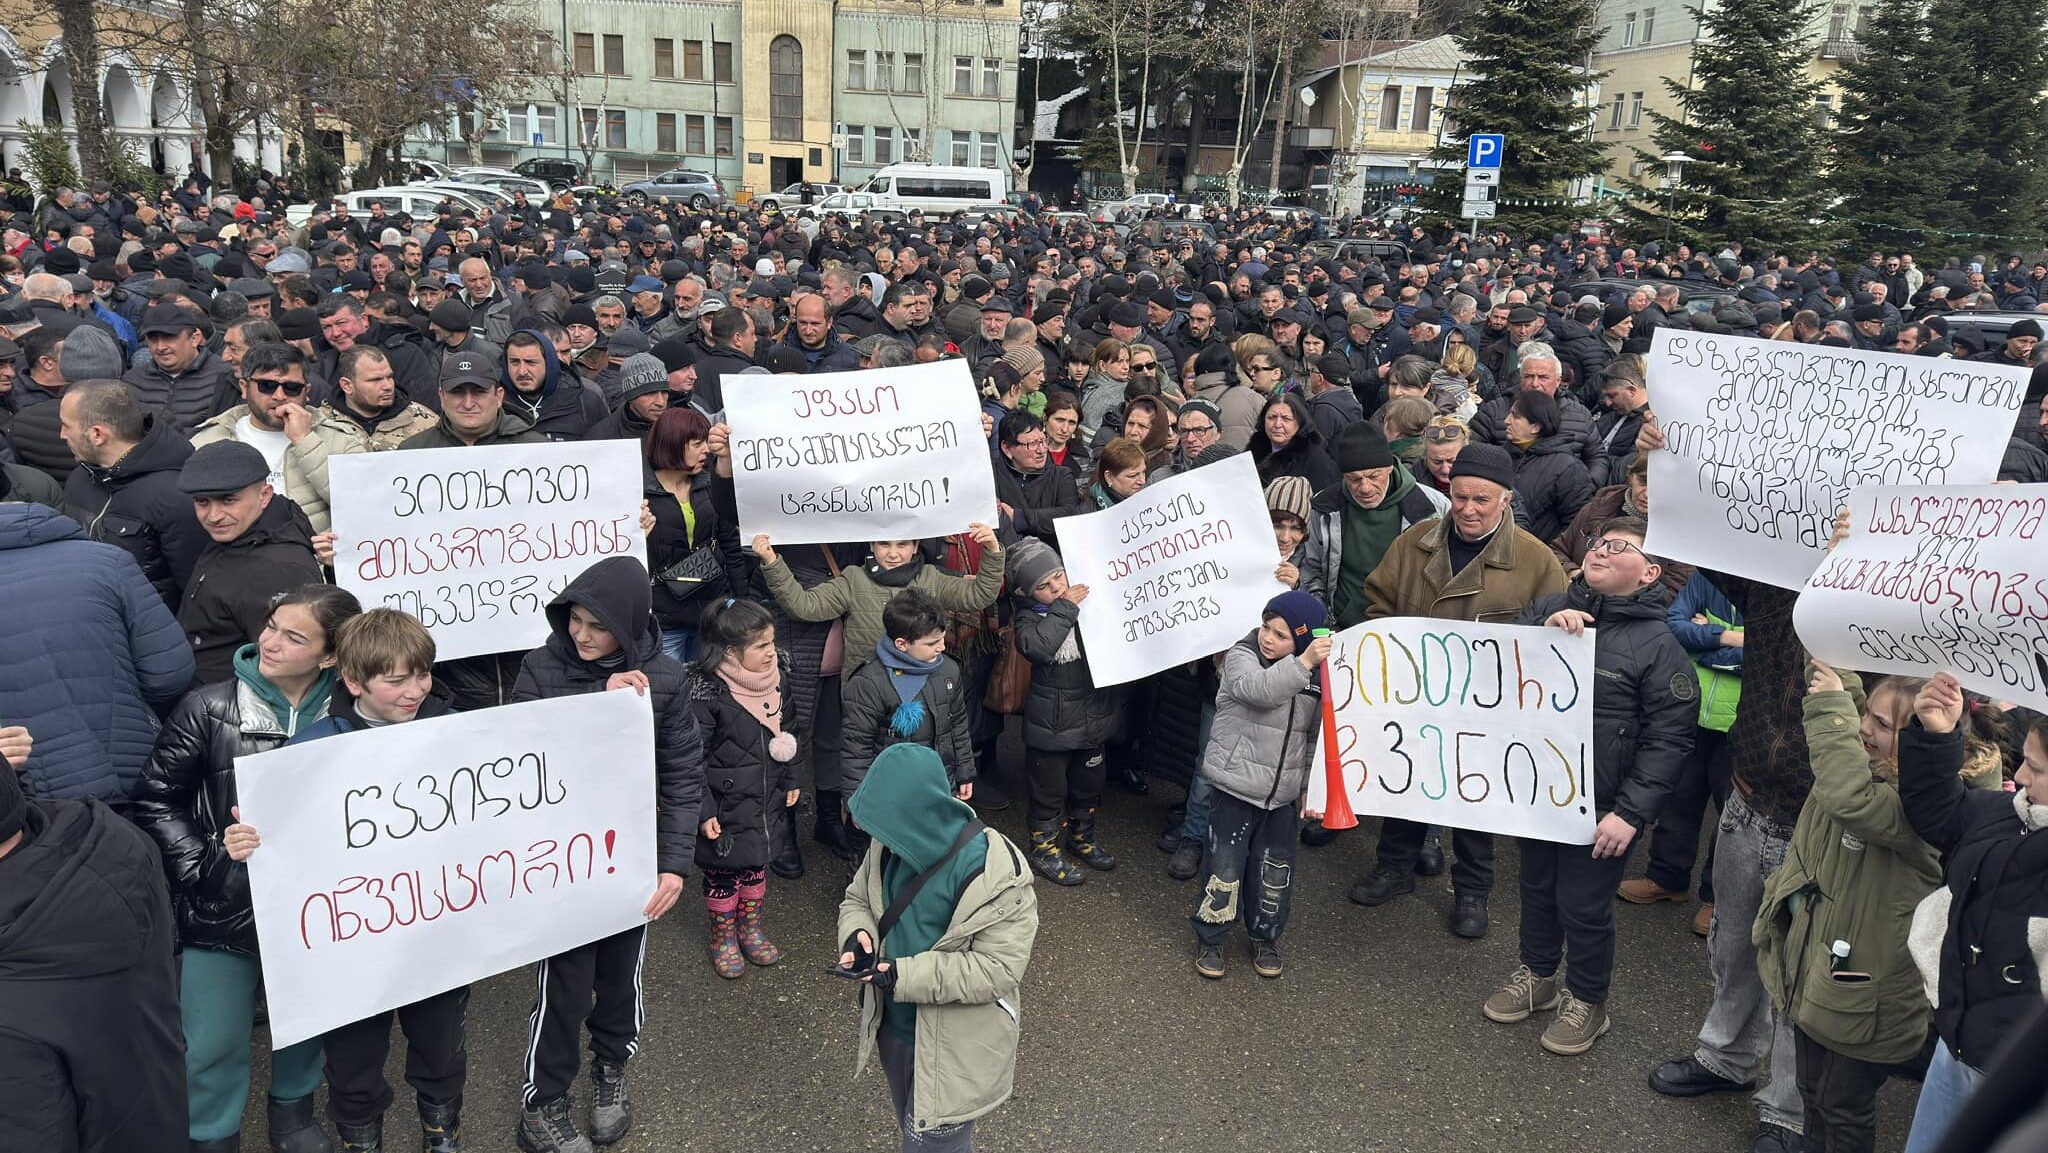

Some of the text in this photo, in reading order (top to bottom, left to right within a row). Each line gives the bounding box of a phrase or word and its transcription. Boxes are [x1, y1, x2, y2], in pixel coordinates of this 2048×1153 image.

[1475, 138, 1496, 165] P
[791, 385, 899, 418] უფასო
[1718, 370, 1919, 427] მოთხოვნების
[392, 464, 590, 517] ვითხოვთ
[1120, 492, 1205, 544] ქალაქის
[357, 514, 632, 581] მთავრობასთან
[1107, 518, 1233, 581] ეკოლოგიური
[1123, 559, 1229, 611] პრობლემის
[1123, 595, 1221, 643] მოგვარება
[344, 752, 567, 849] წავიდეს
